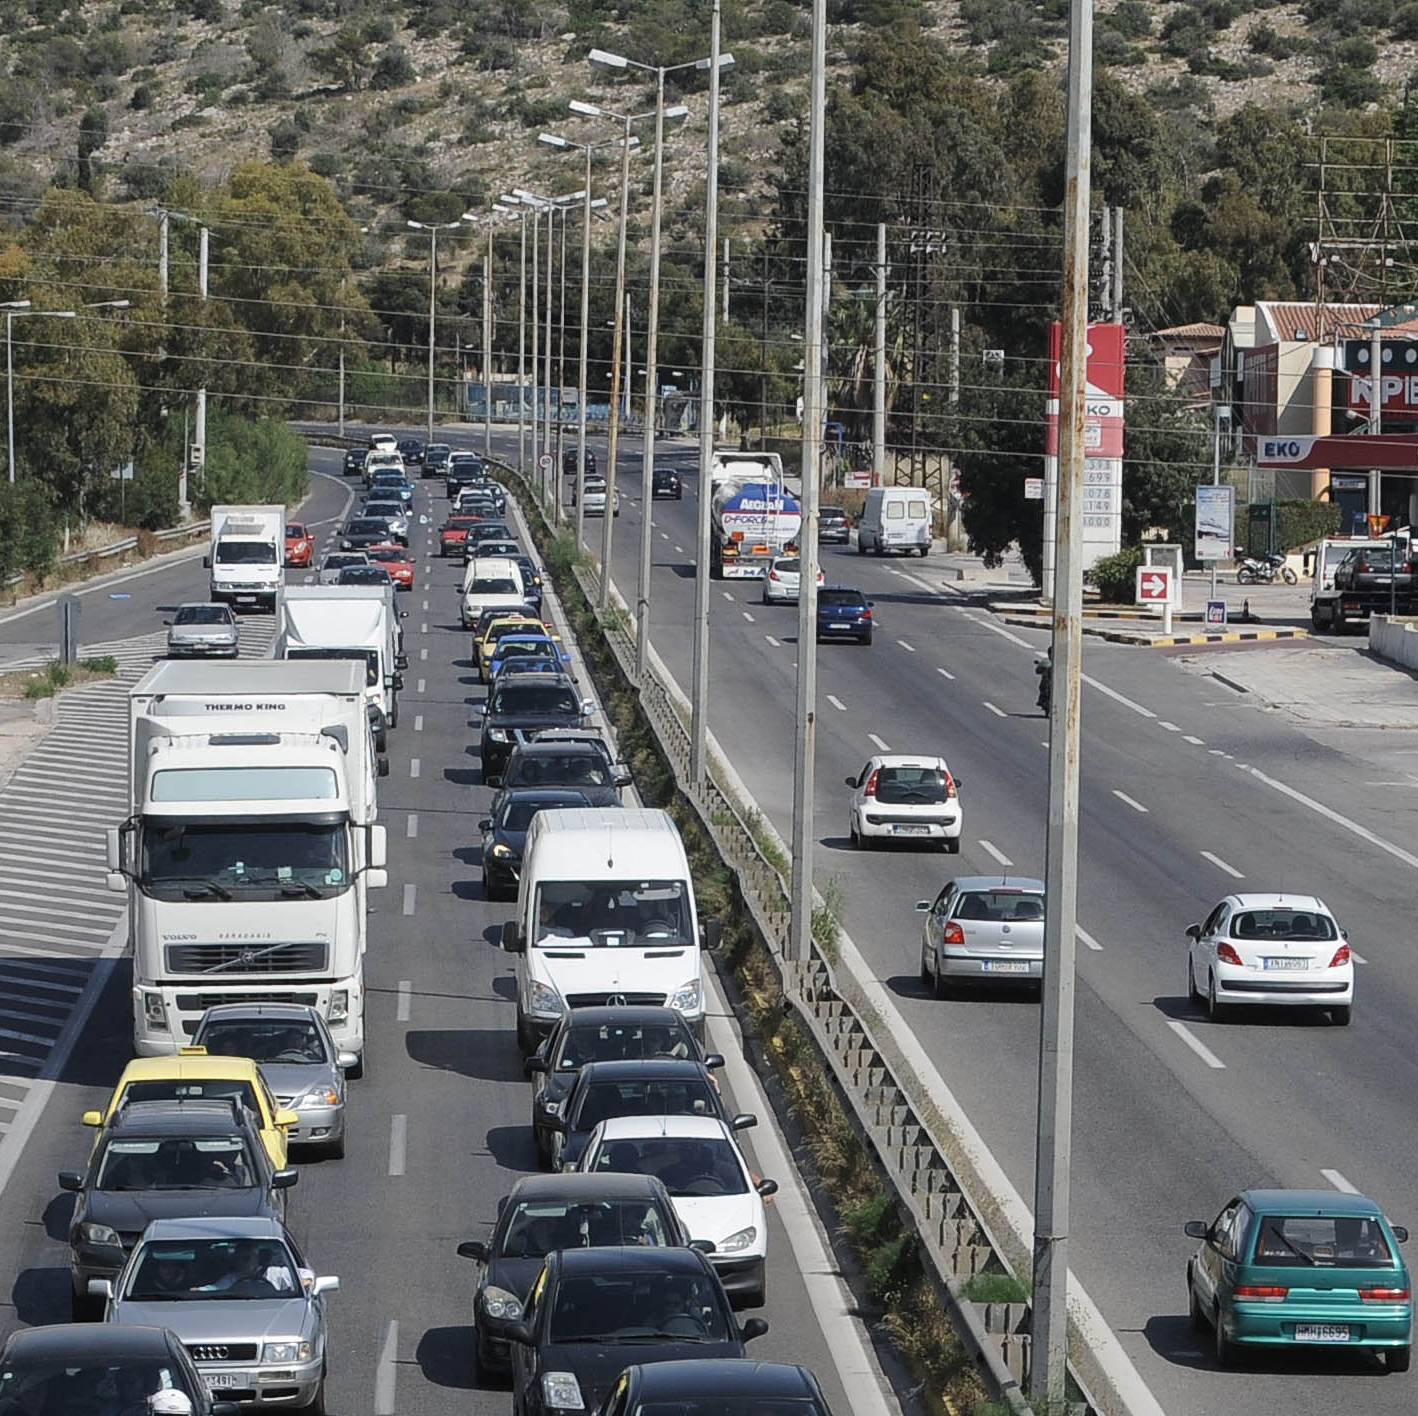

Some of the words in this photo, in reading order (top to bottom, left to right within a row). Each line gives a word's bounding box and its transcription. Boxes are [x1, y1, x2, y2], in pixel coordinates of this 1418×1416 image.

[1087, 404, 1111, 416] KO
[1264, 441, 1301, 458] EKO
[205, 703, 253, 711] THERMO
[256, 703, 286, 711] KING
